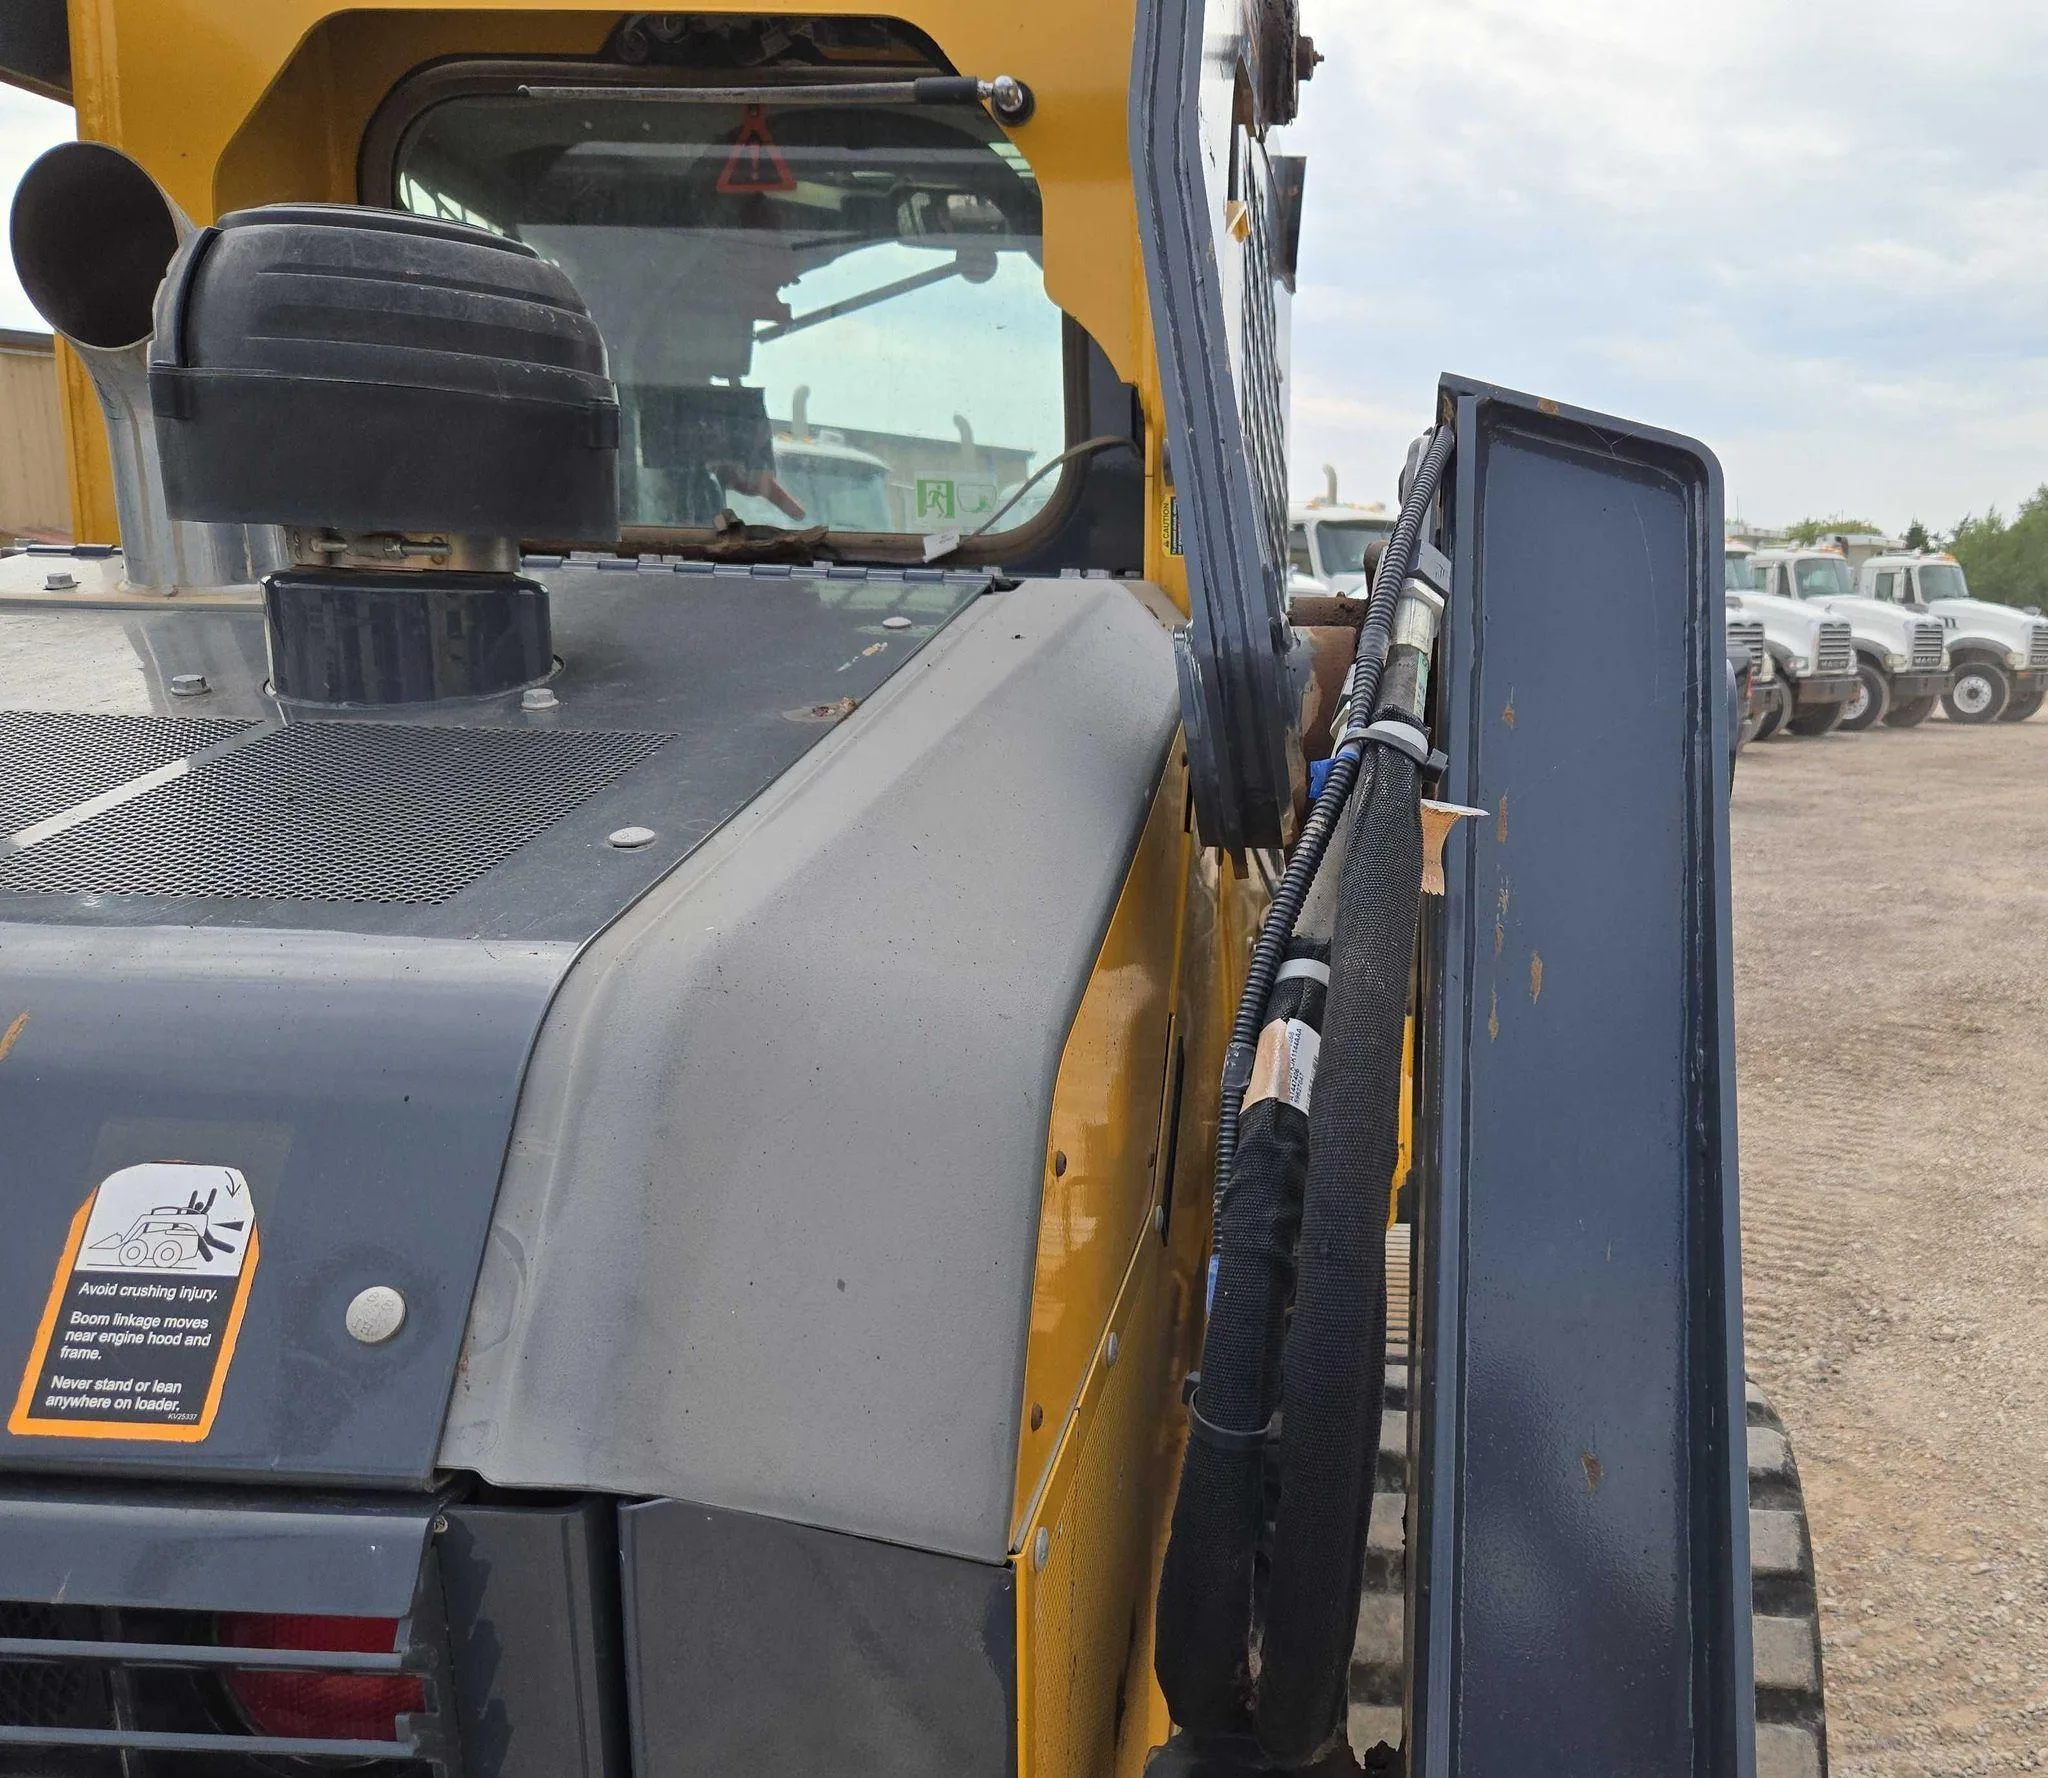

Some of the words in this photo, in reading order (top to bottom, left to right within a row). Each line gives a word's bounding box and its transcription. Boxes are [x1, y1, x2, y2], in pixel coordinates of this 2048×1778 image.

[78, 1282, 118, 1296] Avoid
[119, 1284, 176, 1300] crushing
[179, 1286, 218, 1302] injury.
[70, 1311, 110, 1325] Boom
[112, 1313, 161, 1329] linkage
[163, 1317, 209, 1329] moves
[65, 1331, 97, 1342] near
[99, 1331, 144, 1346] engine
[147, 1332, 182, 1345] hood
[184, 1334, 211, 1347] and
[60, 1345, 102, 1360] frame.
[51, 1375, 93, 1390] Never
[94, 1378, 133, 1392] stand
[135, 1381, 152, 1392] or
[152, 1379, 182, 1394] lean
[45, 1394, 111, 1409] anywhere
[113, 1398, 132, 1409] on
[134, 1397, 180, 1411] loader.
